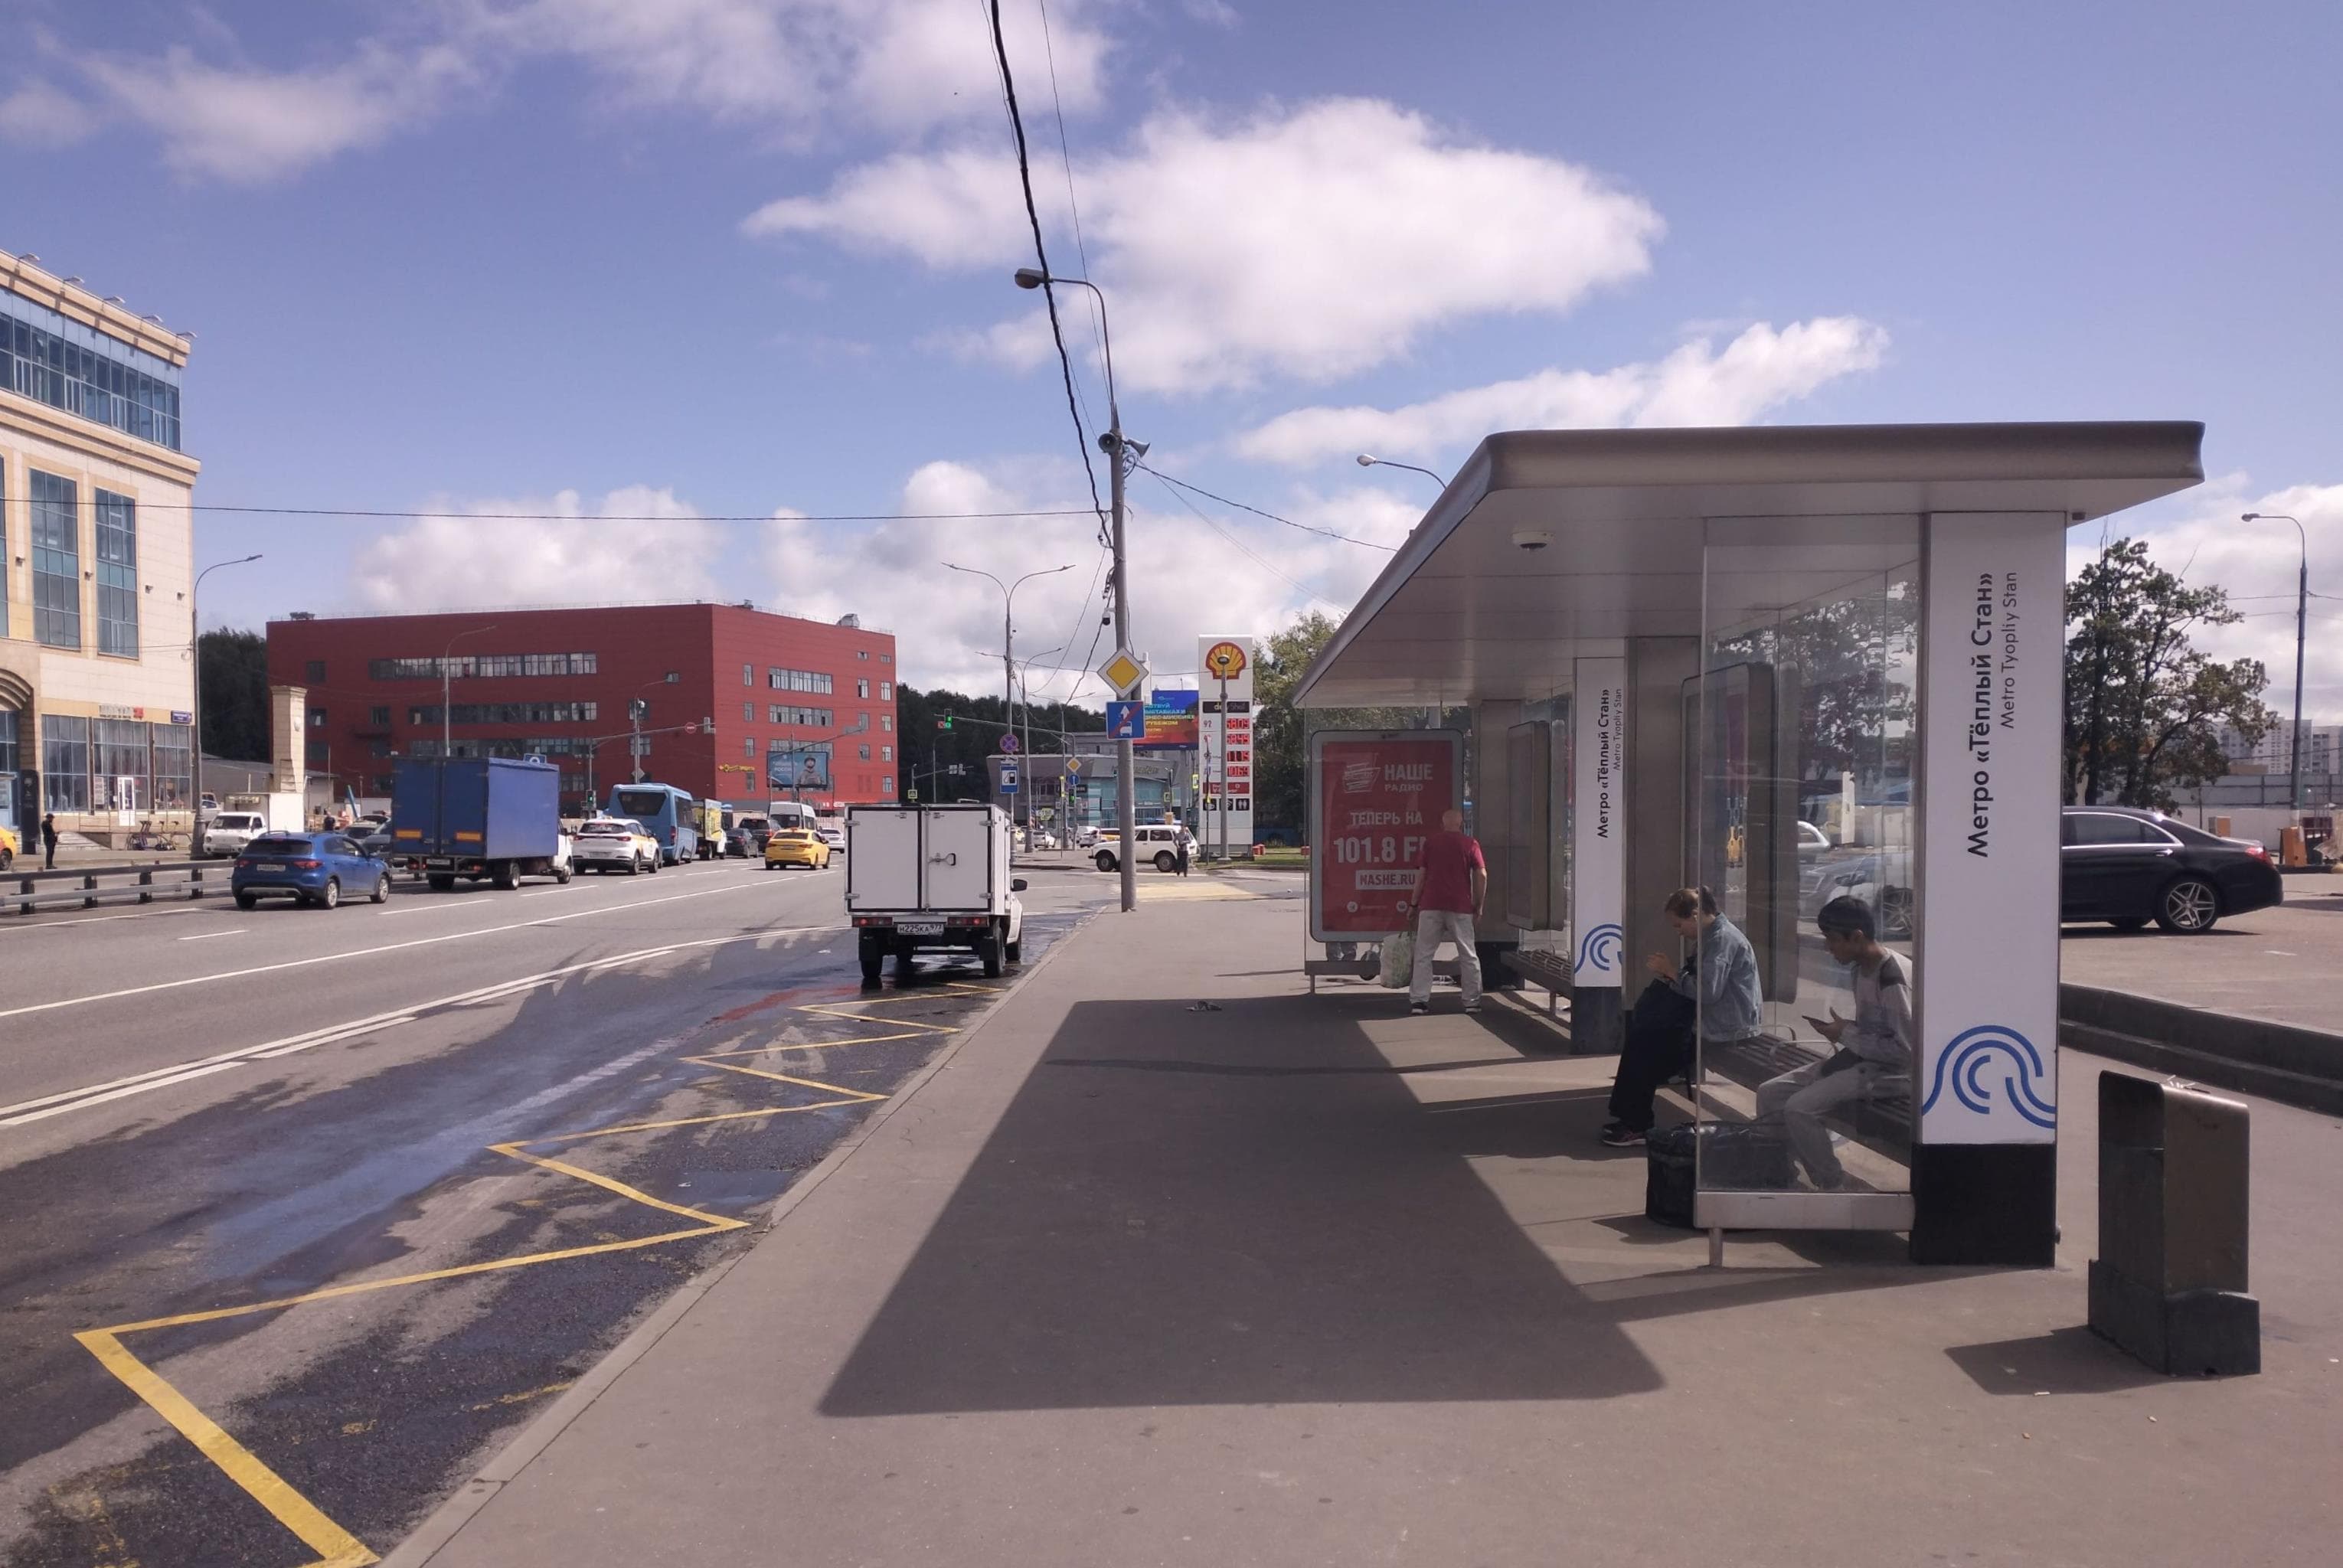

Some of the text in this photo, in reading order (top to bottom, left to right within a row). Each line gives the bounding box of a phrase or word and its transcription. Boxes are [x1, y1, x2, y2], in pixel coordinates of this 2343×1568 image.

[2000, 573, 2021, 729] Metro Tyopliy Stan
[1613, 689, 1622, 709] Stan
[1967, 573, 1994, 858] Метро «Тёплый Стан»
[1384, 764, 1433, 780] НАШЕ
[1597, 689, 1611, 838] Метро «Тёплый Стан»
[1384, 784, 1423, 792] РАДИО
[1350, 812, 1423, 825] ТЕПЕРЬ НА
[1334, 836, 1397, 863] 101.8
[1360, 874, 1416, 886] NASHE.RU
